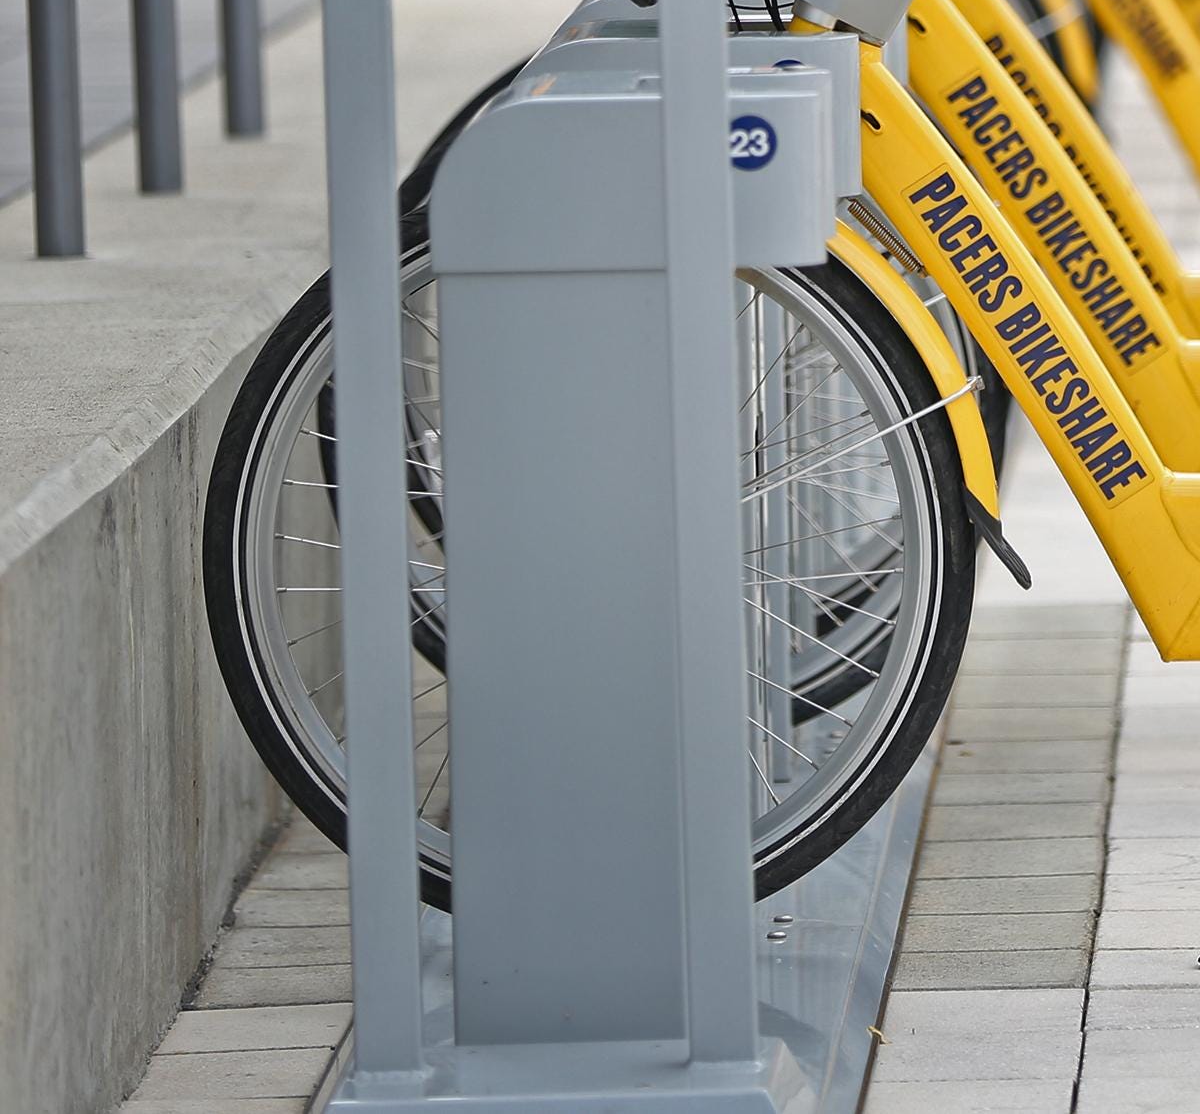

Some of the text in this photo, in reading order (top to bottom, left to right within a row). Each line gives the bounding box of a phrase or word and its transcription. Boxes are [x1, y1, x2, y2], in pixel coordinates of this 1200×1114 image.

[729, 128, 770, 157] 23
[946, 75, 1048, 200] PACERS
[1025, 191, 1162, 367] BIKESHARE
[908, 171, 1023, 313] PACERS
[994, 301, 1148, 501] BIKESHARE
